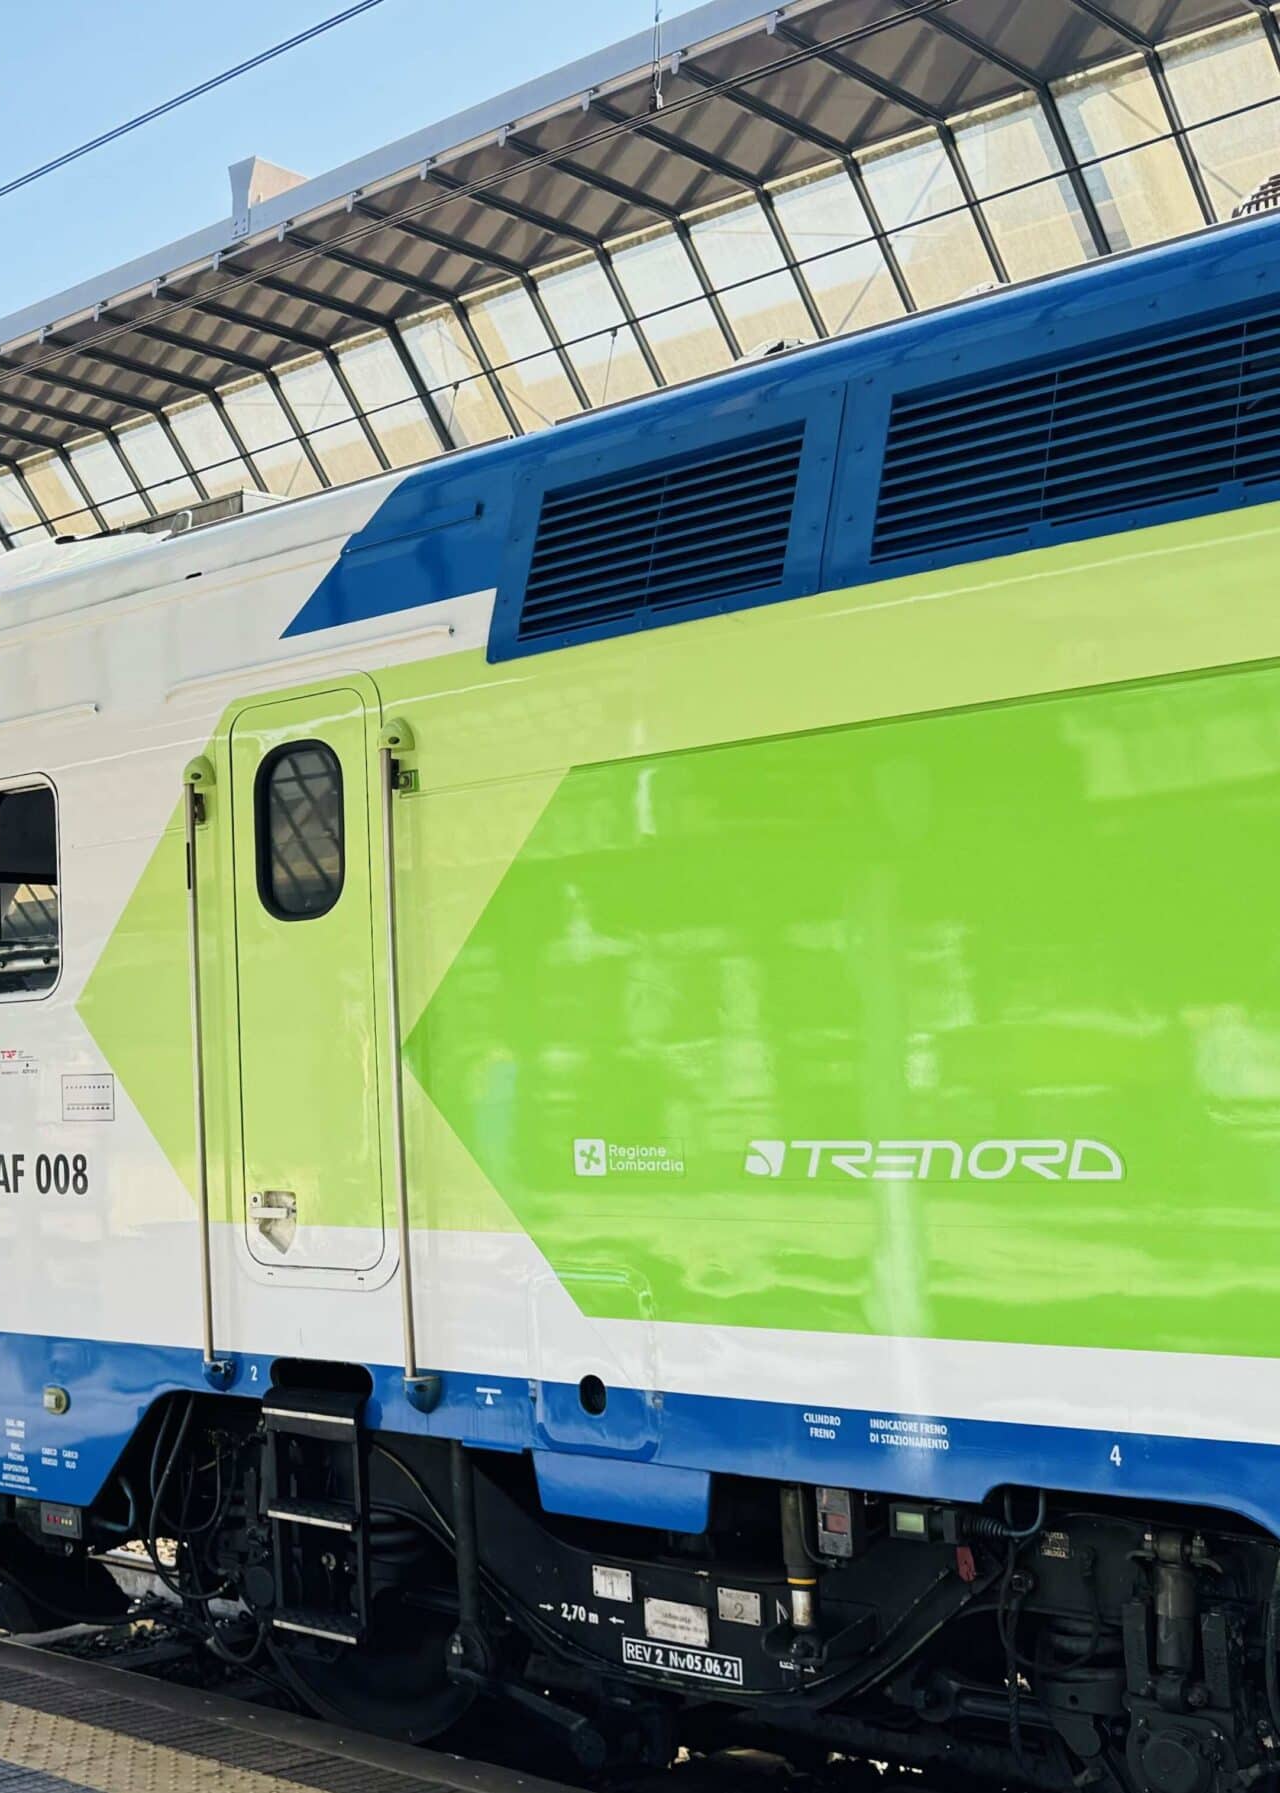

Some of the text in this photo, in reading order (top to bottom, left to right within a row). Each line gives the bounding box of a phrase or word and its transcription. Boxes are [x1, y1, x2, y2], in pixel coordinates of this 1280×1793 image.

[608, 1144, 667, 1160] Regione
[790, 1138, 1122, 1180] TRENORD
[36, 1153, 89, 1195] 008
[609, 1158, 685, 1173] Lombardia
[250, 1365, 259, 1381] 2
[803, 1412, 841, 1427] CILINDRO
[869, 1418, 948, 1436] INDICATORE FRENO
[809, 1426, 836, 1440] FRENO
[869, 1432, 879, 1444] DI
[1110, 1444, 1122, 1467] 4
[561, 1602, 599, 1625] 2,70 m
[734, 1602, 745, 1620] 2
[626, 1642, 652, 1662] REV
[655, 1648, 664, 1665] 2
